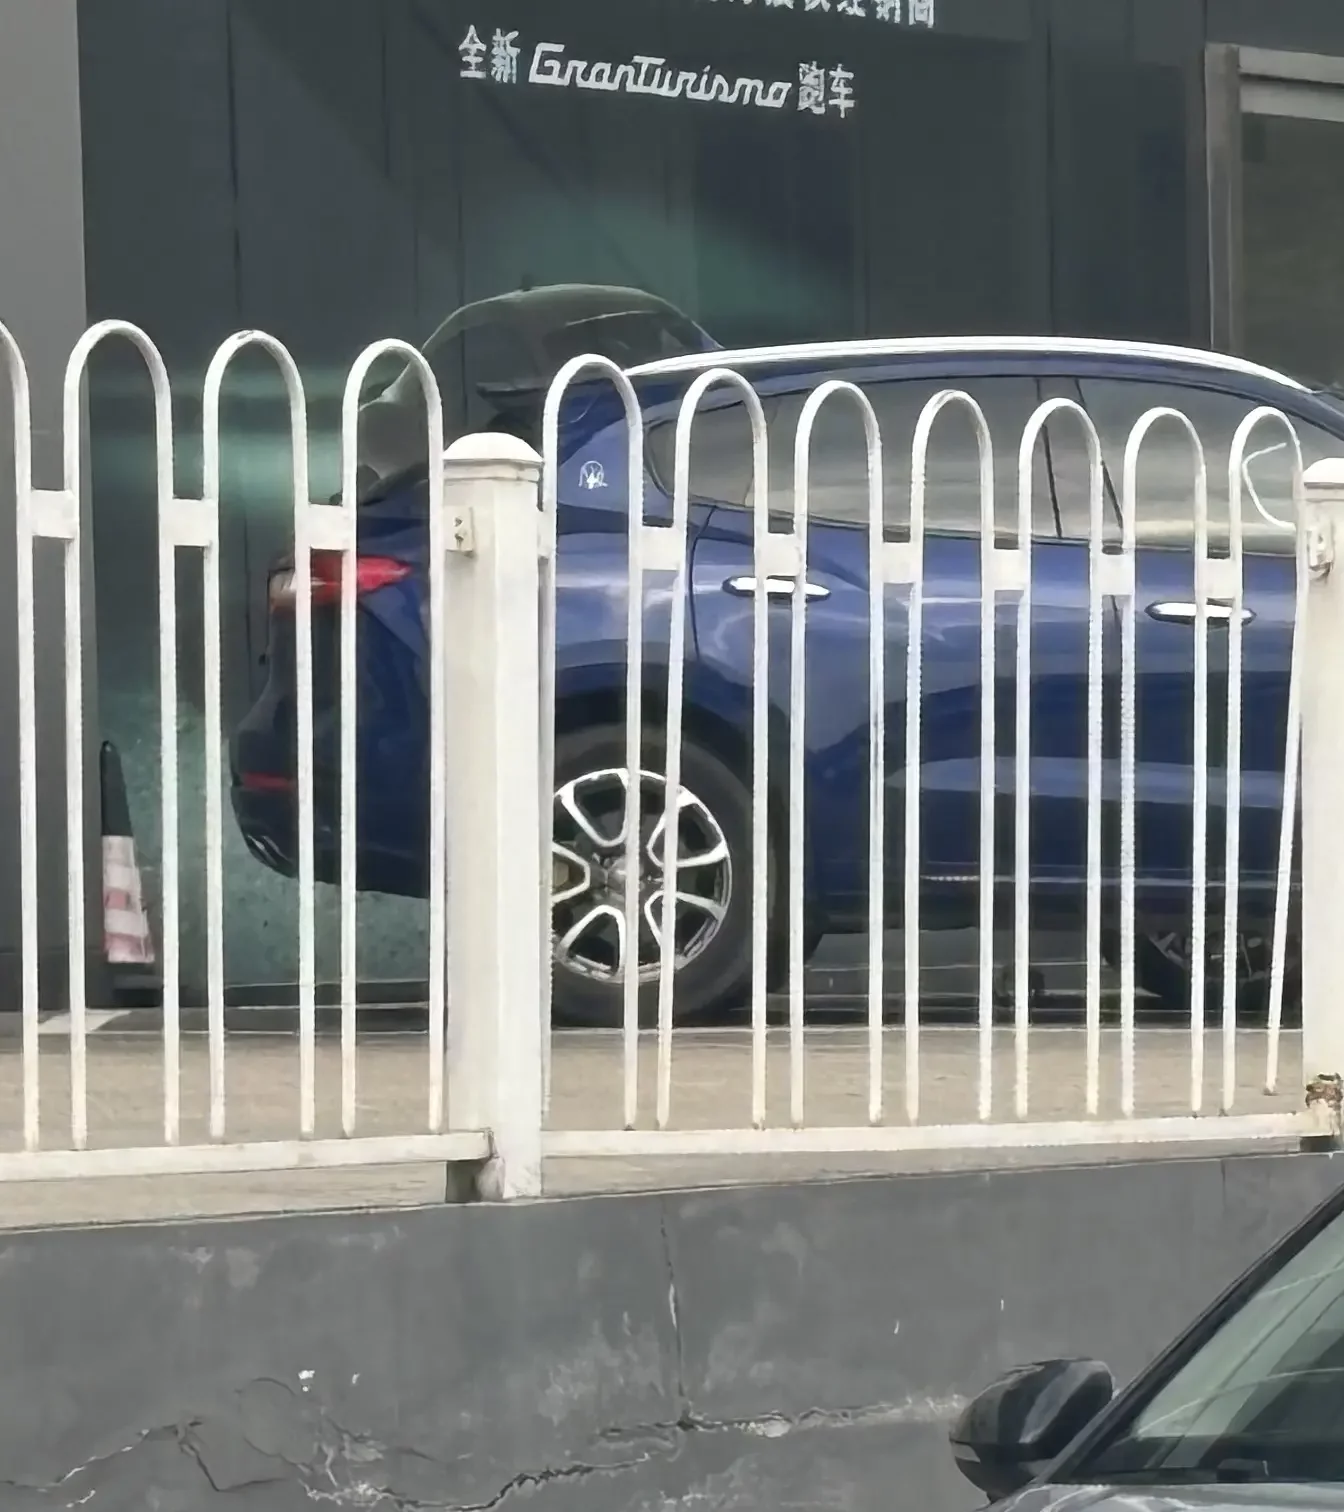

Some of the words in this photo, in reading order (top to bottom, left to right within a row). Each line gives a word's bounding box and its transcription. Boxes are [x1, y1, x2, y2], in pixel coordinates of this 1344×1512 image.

[458, 24, 521, 84] 全新
[528, 42, 793, 109] GranTurismo
[796, 60, 856, 119] 跑车
